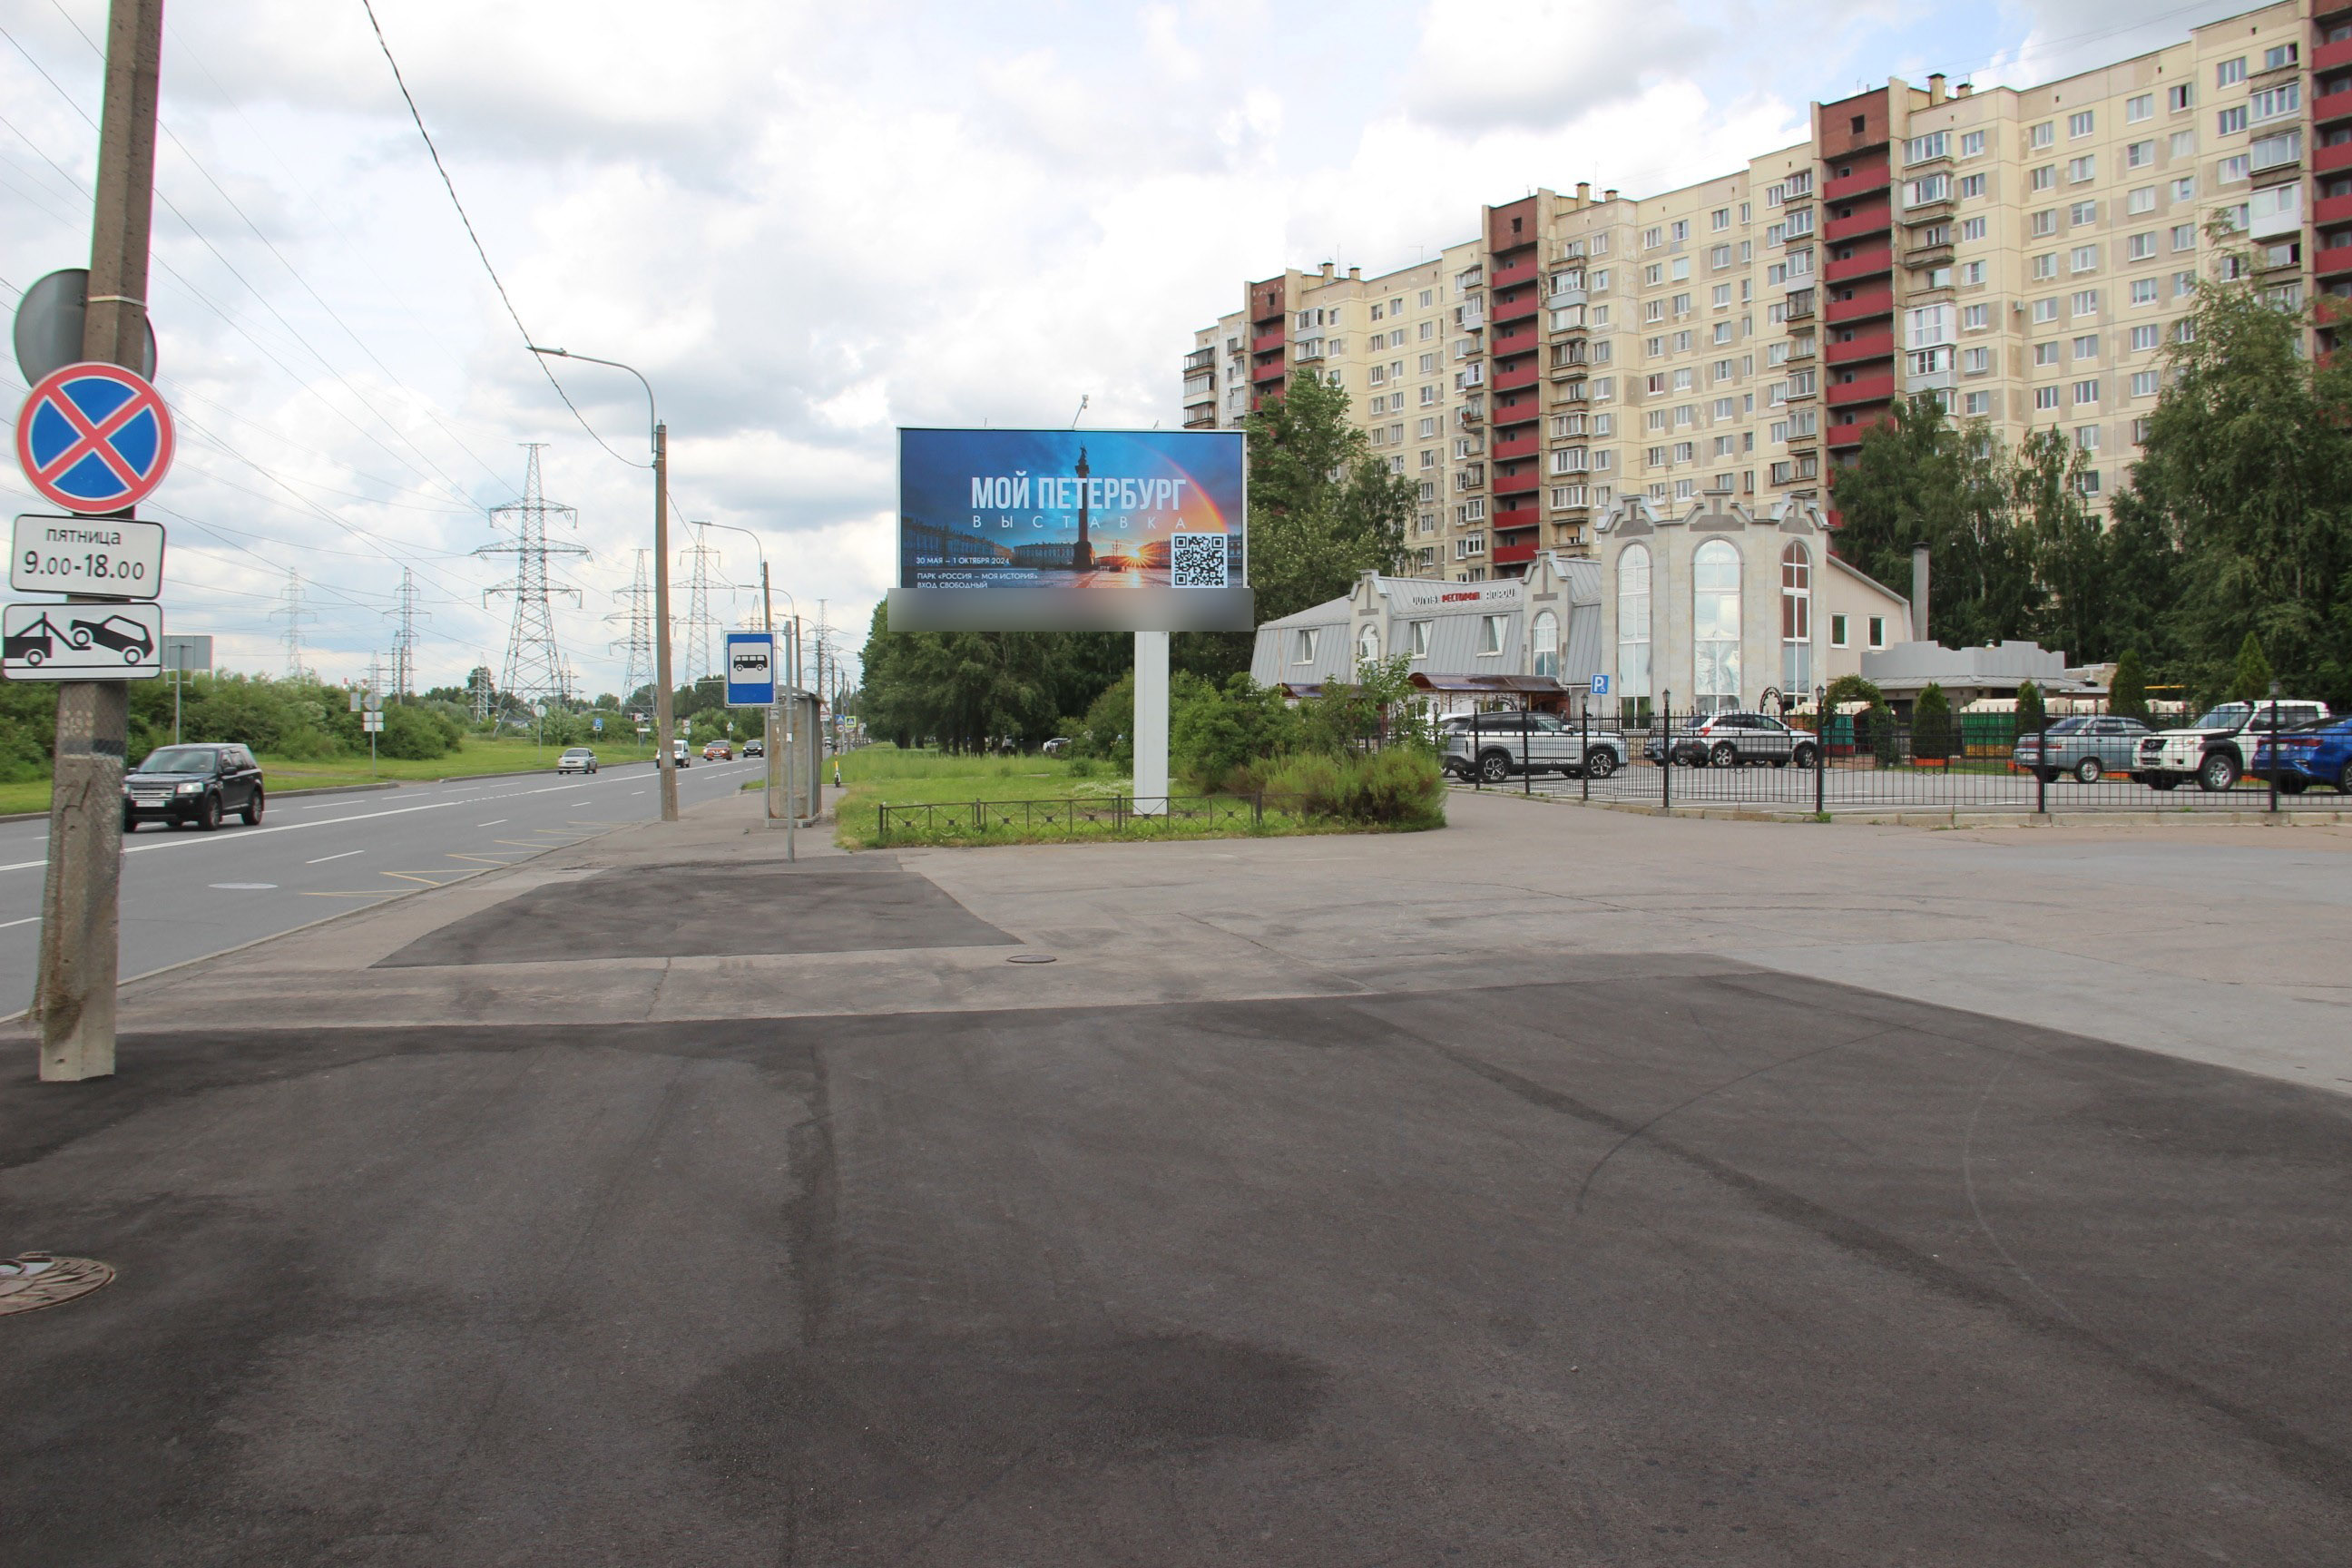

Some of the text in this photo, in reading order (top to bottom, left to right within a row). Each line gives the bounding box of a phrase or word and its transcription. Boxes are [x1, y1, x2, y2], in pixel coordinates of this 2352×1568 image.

[971, 470, 1187, 511] МОЙ ПЕТЕРБУРГ
[973, 515, 1187, 530] ВЫСТАВКА
[45, 528, 122, 546] пятница
[24, 550, 145, 581] 9.00-18.00
[939, 581, 988, 589] СВОБОДНЫЙ
[1593, 676, 1604, 692] P
